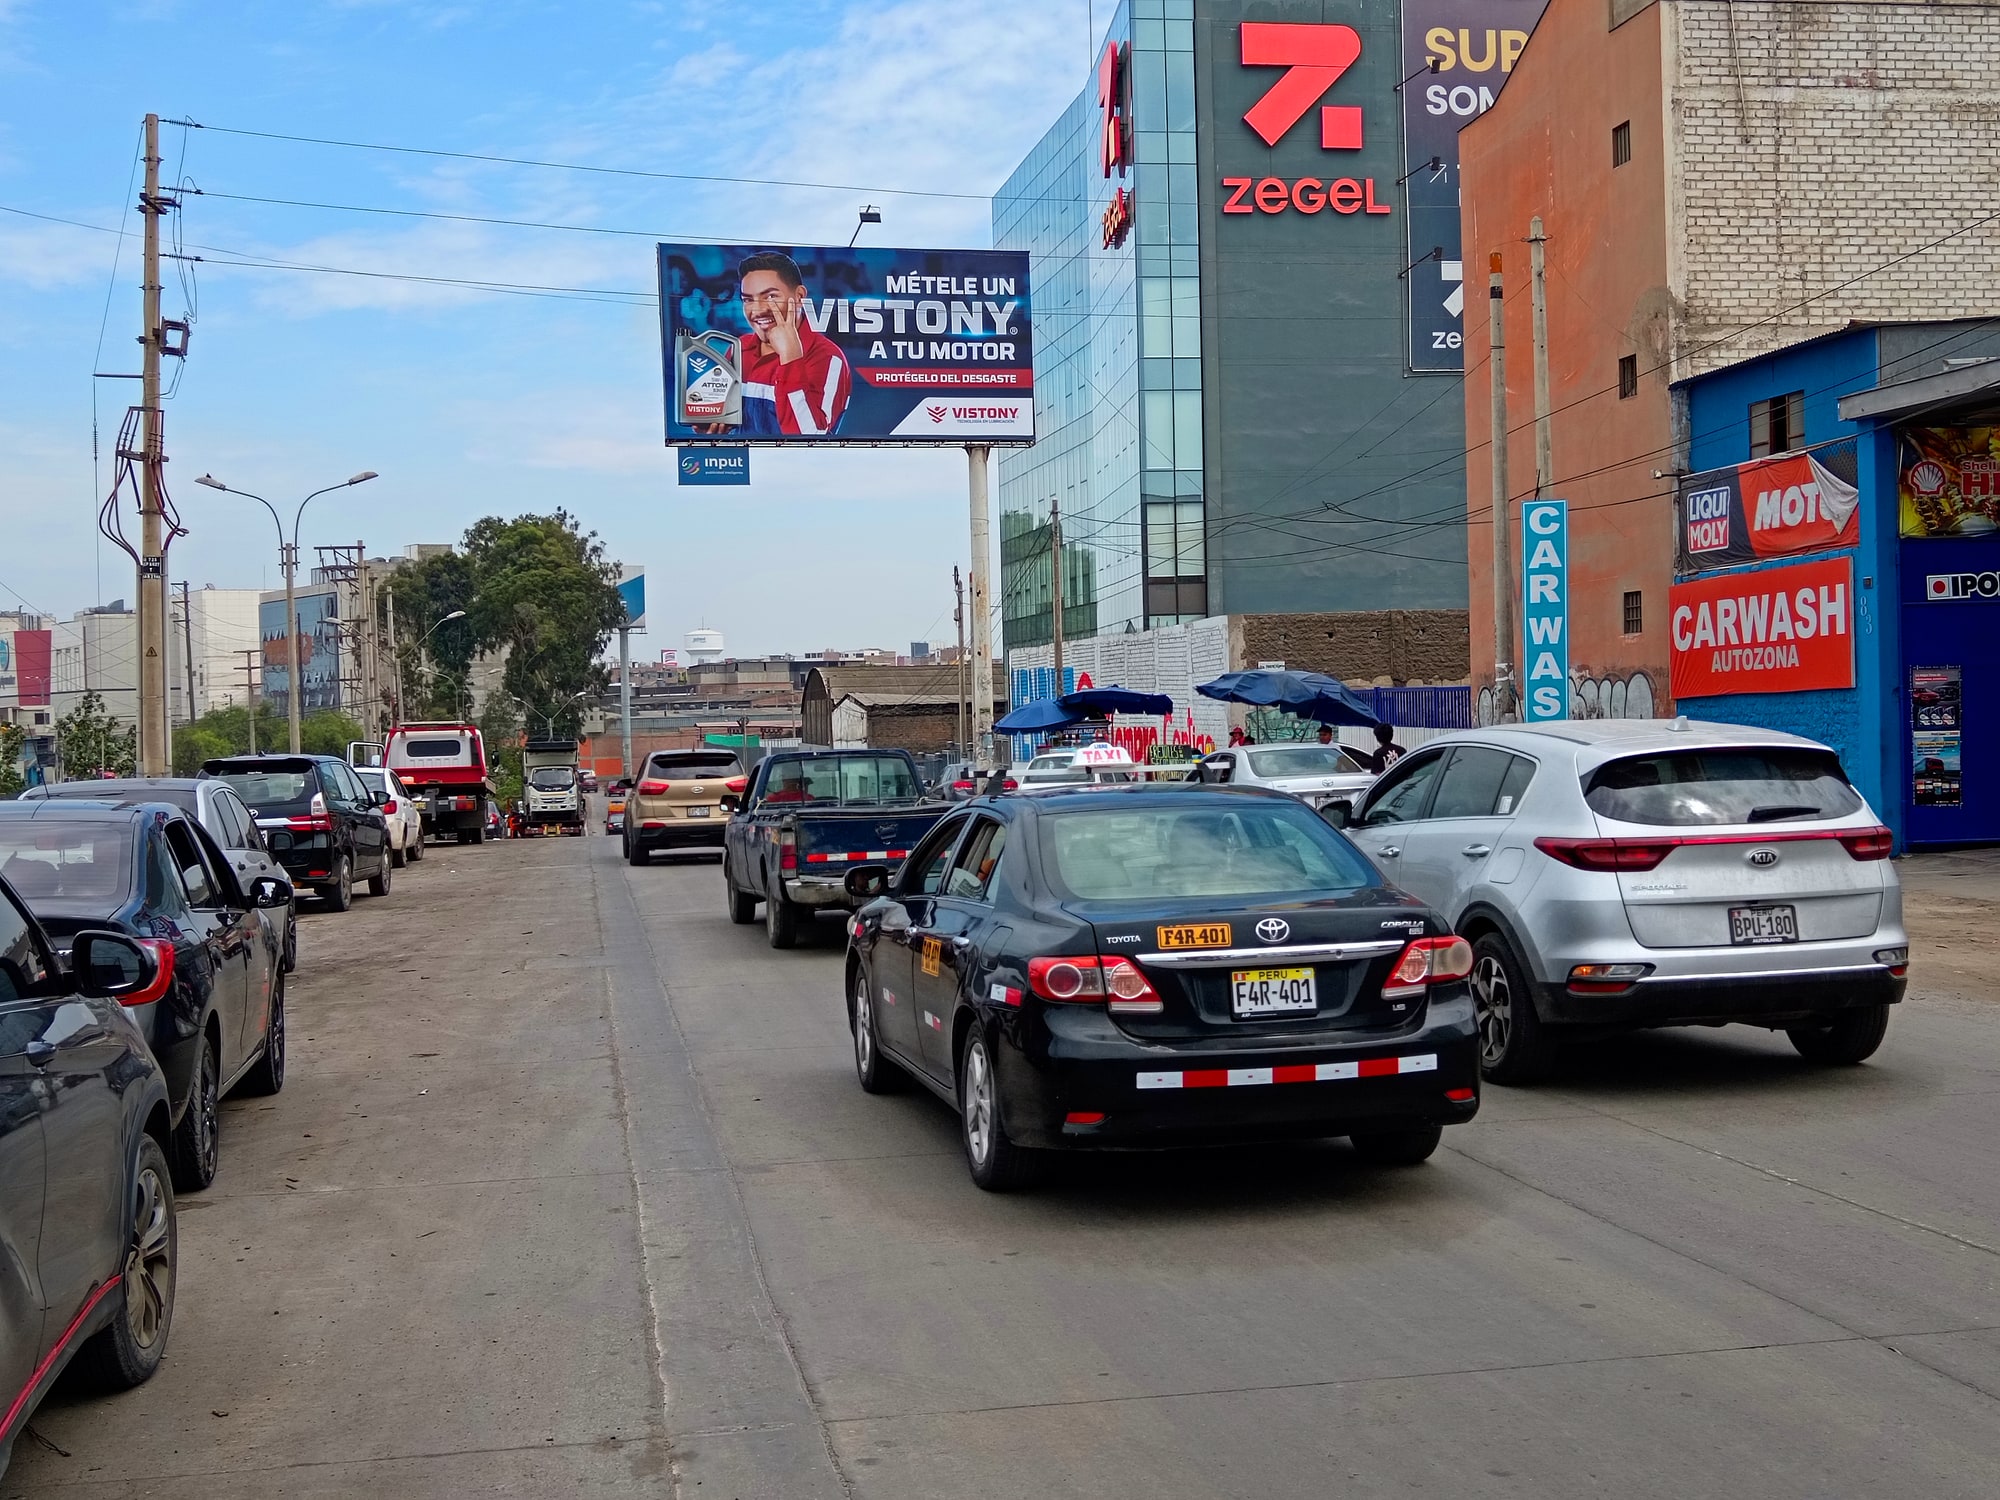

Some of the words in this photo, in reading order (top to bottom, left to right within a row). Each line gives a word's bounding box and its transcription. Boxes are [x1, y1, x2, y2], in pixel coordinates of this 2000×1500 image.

[1425, 27, 1530, 73] SUP
[886, 270, 979, 295] MÉTELE
[982, 277, 1015, 296] UN
[1432, 331, 1462, 349] ze
[869, 341, 888, 359] A
[891, 342, 925, 360] TU
[930, 342, 1016, 361] MOTOR
[875, 371, 939, 383] PROTÉGELO
[940, 374, 961, 383] DEL
[962, 374, 1017, 384] DESGASTE
[687, 405, 721, 414] VISTONY
[1963, 461, 1997, 471] Shell
[1689, 490, 1727, 521] LIQUI
[1689, 519, 1727, 549] MOLY
[1951, 572, 2000, 599] IPO
[1672, 583, 1846, 652] CARWASH
[1711, 644, 1800, 673] AUTOZONA
[1083, 749, 1122, 763] TAXI
[1754, 853, 1774, 863] KIA
[1381, 921, 1425, 929] COROLLA
[1733, 915, 1793, 938] BPU-180
[1106, 935, 1142, 944] TOYOTA
[1163, 927, 1227, 945] F4R-401
[1258, 970, 1288, 980] PERU
[1235, 978, 1313, 1008] F4R-401
